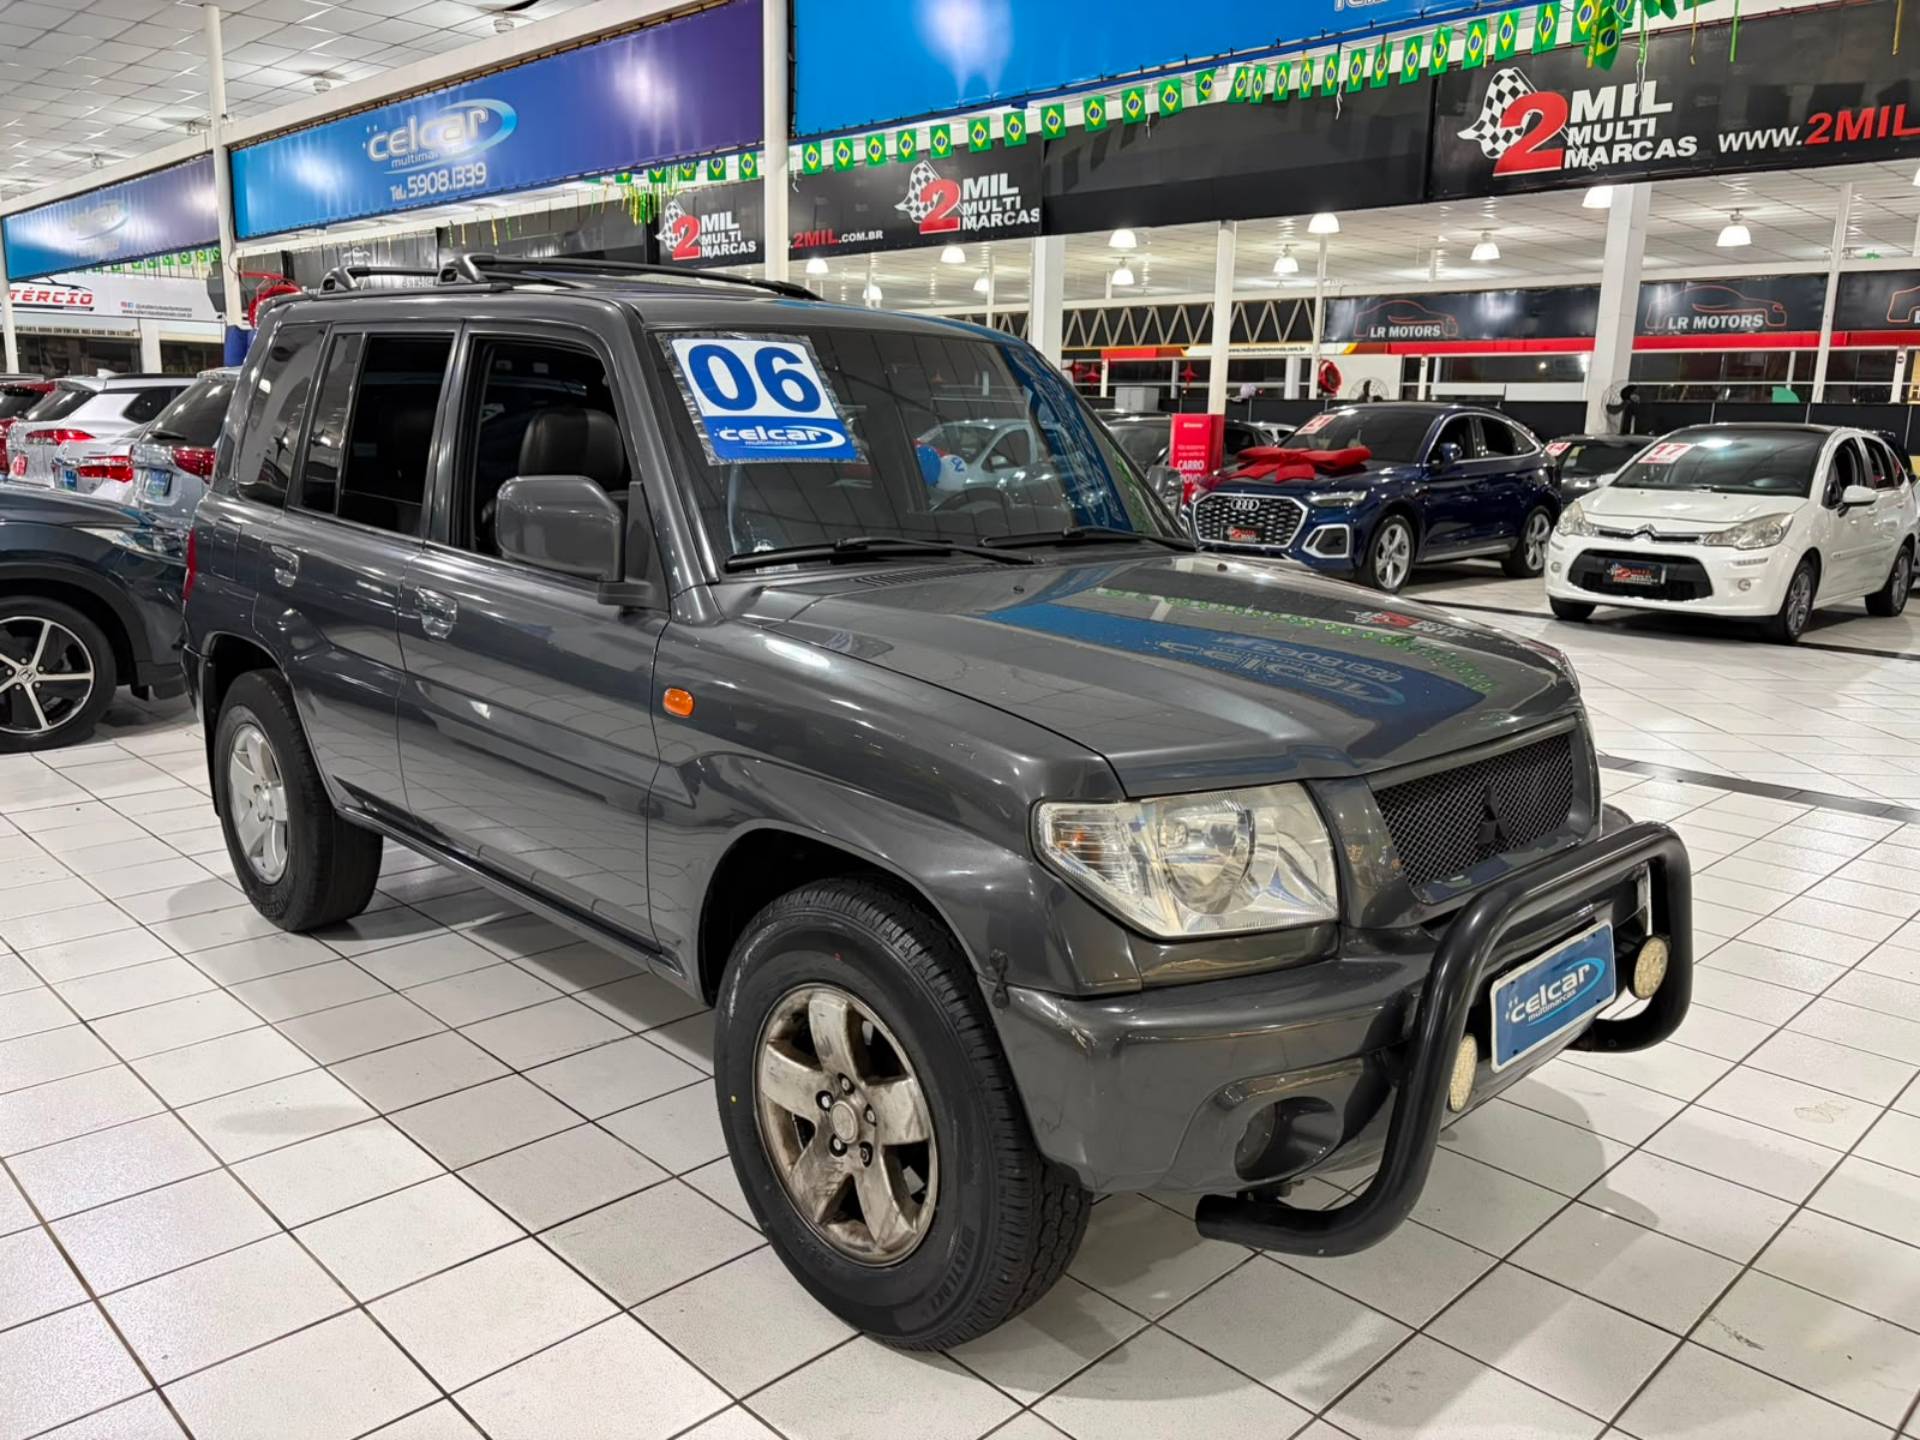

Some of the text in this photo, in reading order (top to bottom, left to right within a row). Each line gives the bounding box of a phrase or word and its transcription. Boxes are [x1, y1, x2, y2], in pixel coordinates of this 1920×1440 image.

[367, 107, 489, 162] celcar
[1493, 80, 1673, 176] 2 MIL
[1567, 118, 1656, 145] MULTI
[1564, 136, 1698, 169] MARCAS
[408, 162, 487, 199] 5908.1339
[919, 173, 1019, 234] 2 MIL
[962, 196, 1022, 215] MULTI
[962, 208, 1040, 230] MARCAS
[672, 211, 740, 261] 2 MIL
[702, 231, 742, 247] MULTI
[702, 241, 756, 258] MARCAS
[10, 287, 93, 305] TÉRCIO
[1369, 325, 1441, 338] LR MOTORS
[1668, 313, 1764, 330] LR MOTORS
[688, 344, 822, 414] 06
[719, 426, 823, 441] celcar
[1177, 460, 1205, 471] CARRO
[1509, 963, 1590, 1024] celcar
[1527, 990, 1577, 1022] multimarcas
